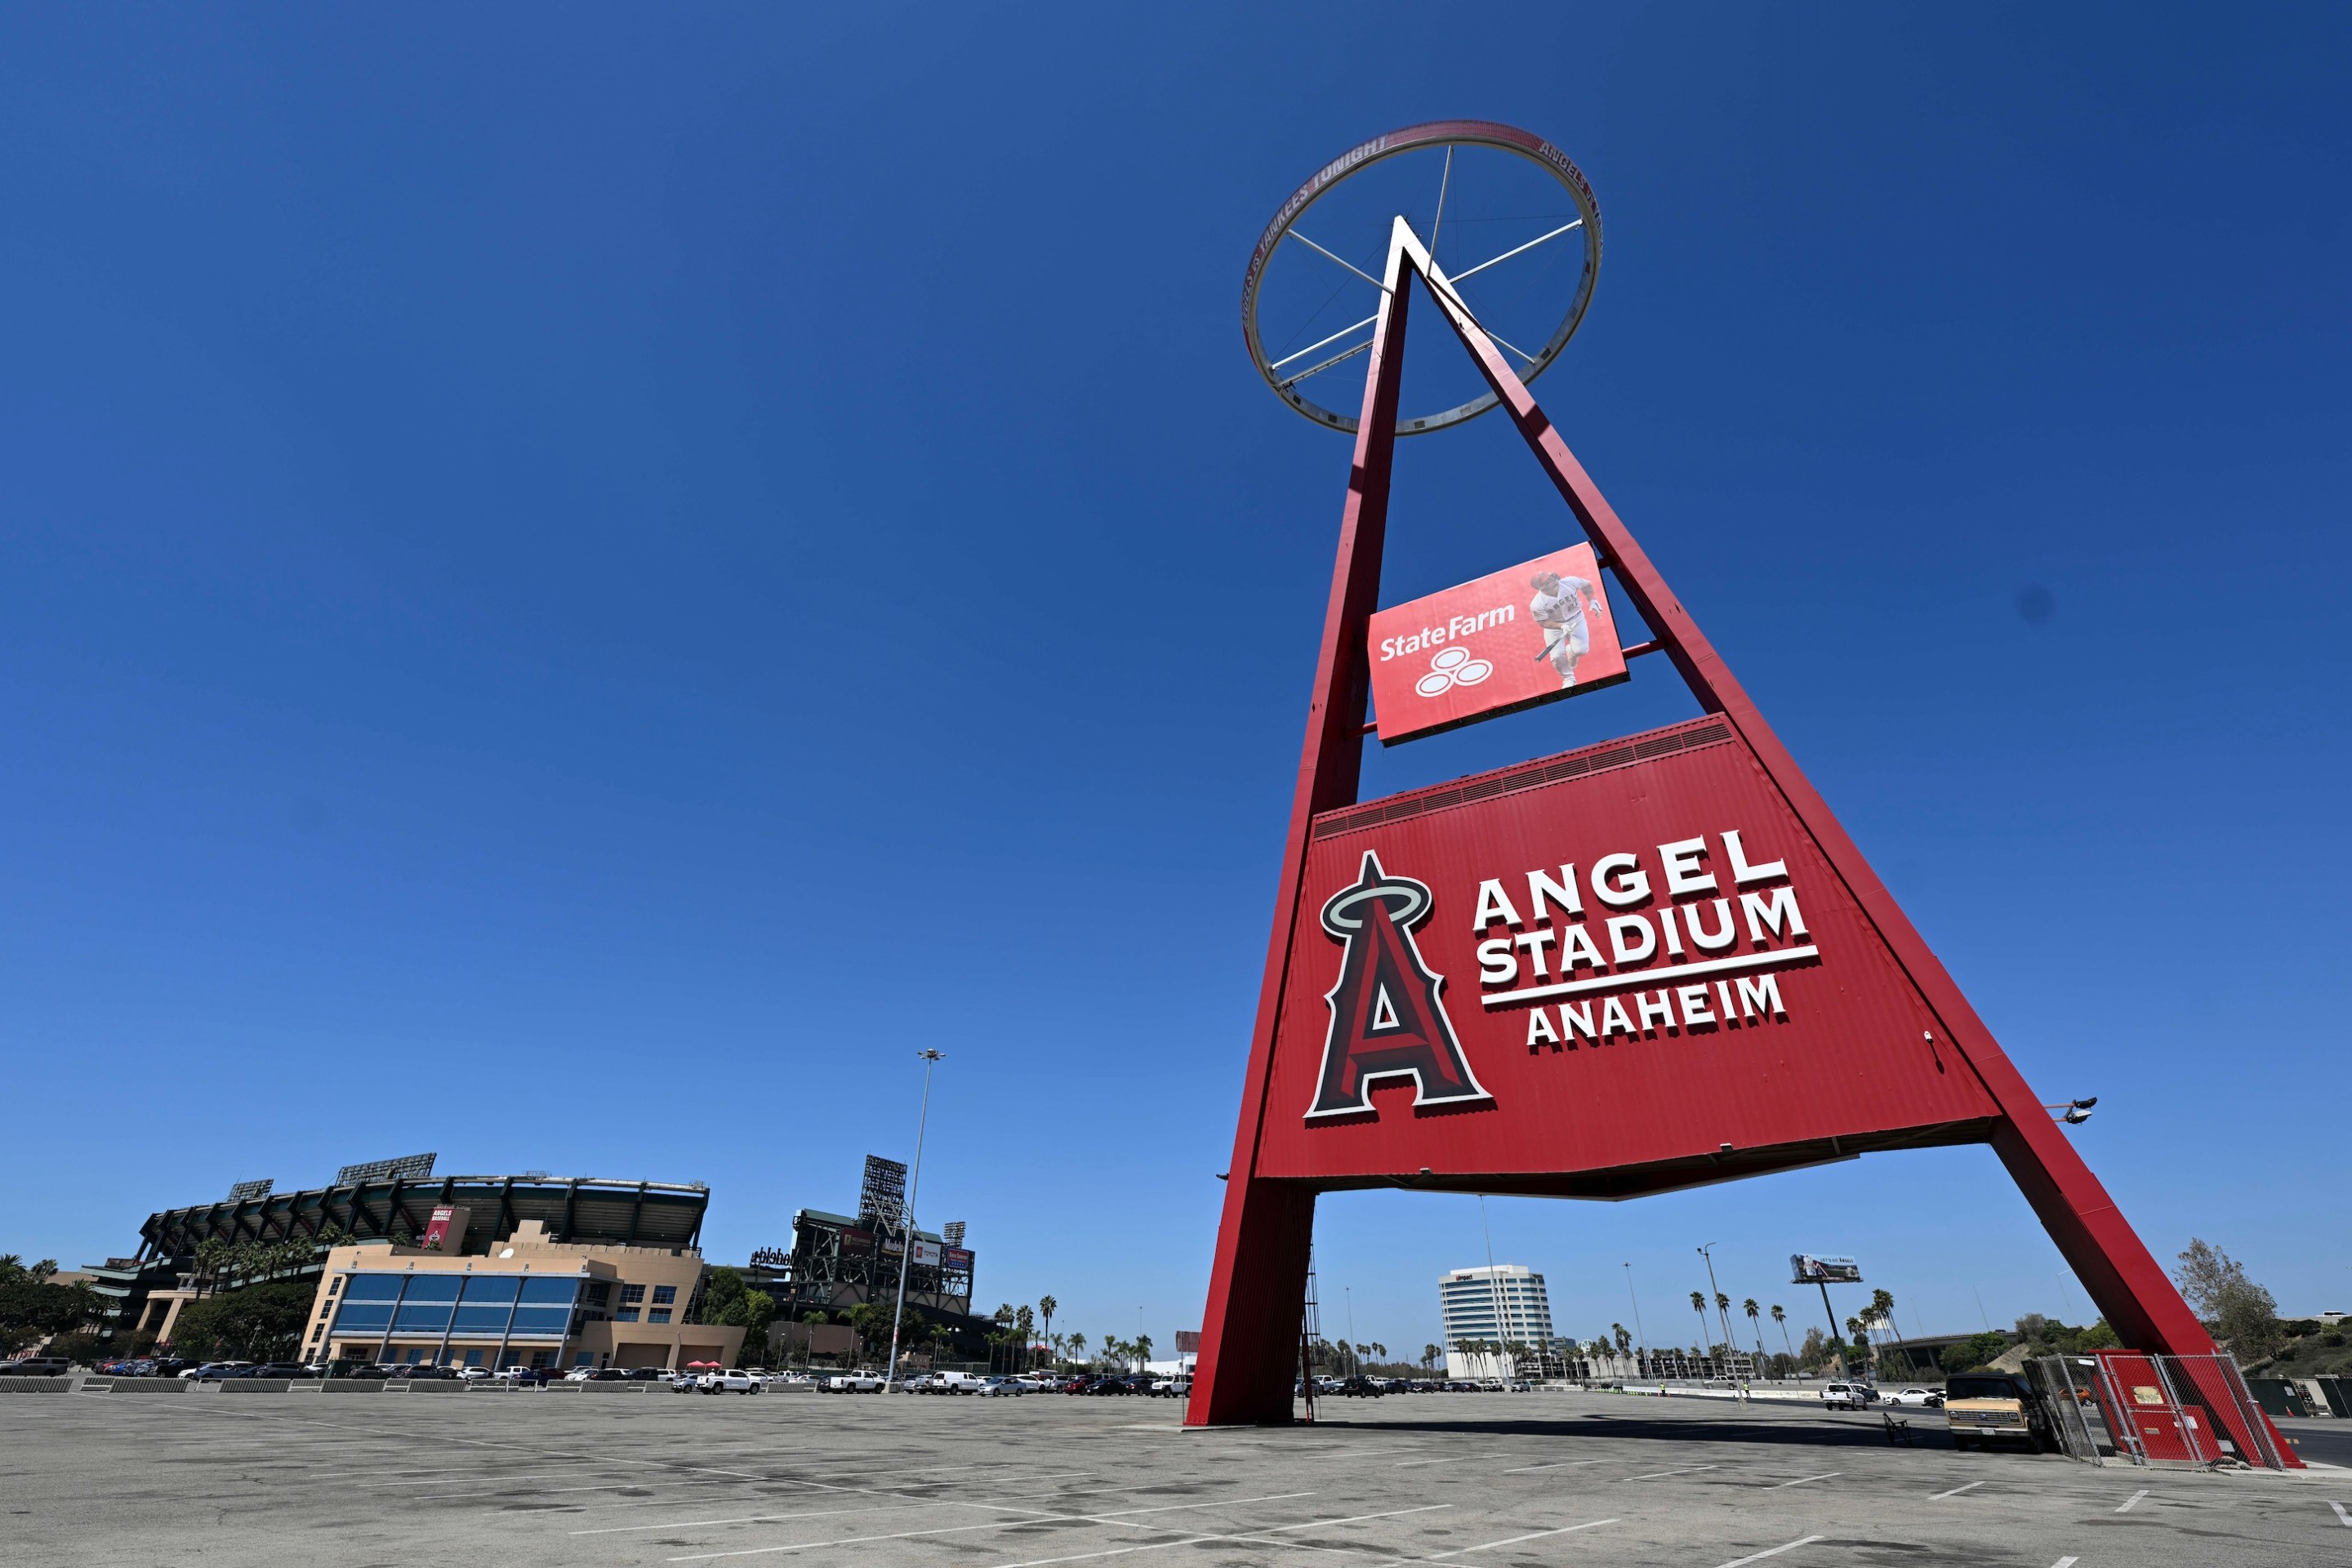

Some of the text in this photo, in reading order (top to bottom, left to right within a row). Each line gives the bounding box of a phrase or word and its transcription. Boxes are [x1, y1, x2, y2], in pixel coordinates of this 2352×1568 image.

[1258, 184, 1308, 253] YANKEES
[1312, 135, 1386, 188] TONIGHT
[1539, 141, 1586, 189] ANGELS
[1380, 604, 1515, 662] State Farm
[1472, 829, 1788, 932] ANGEL
[1476, 886, 1810, 984] STADIUM
[1303, 849, 1494, 1120] A
[1526, 973, 1787, 1046] ANAHEIM
[884, 1238, 904, 1252] Modelo
[924, 1250, 938, 1258] TOYOTA
